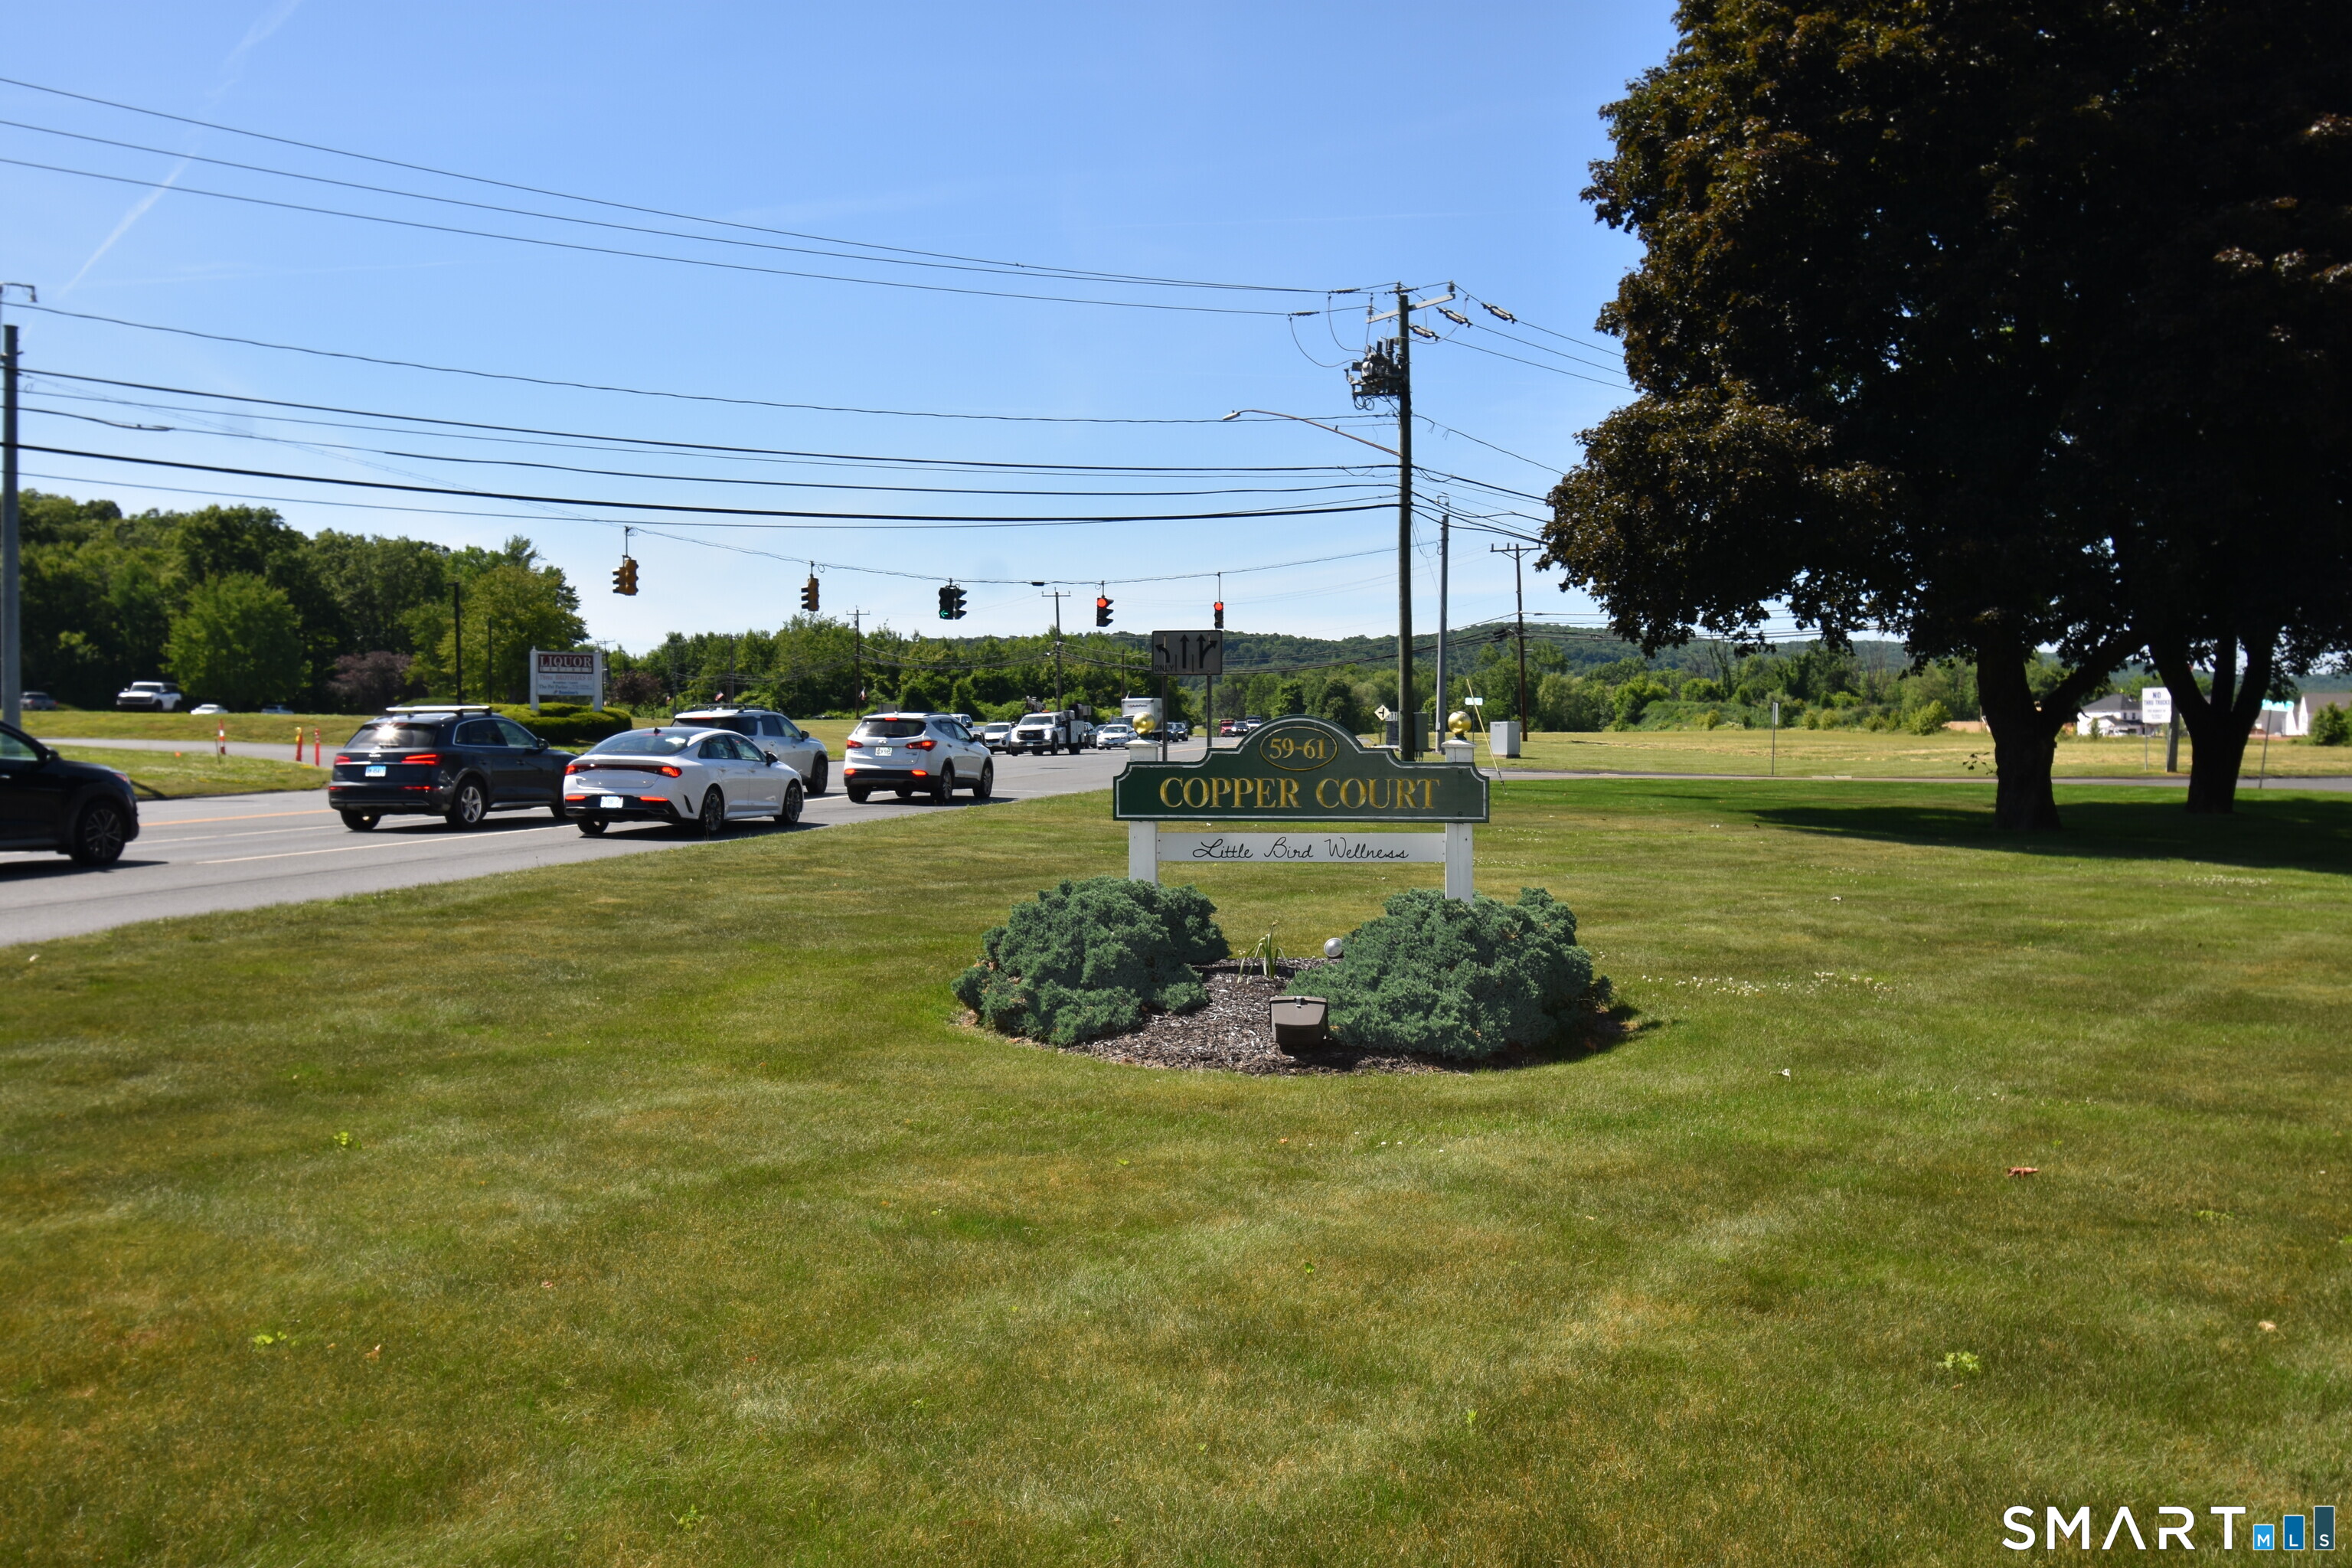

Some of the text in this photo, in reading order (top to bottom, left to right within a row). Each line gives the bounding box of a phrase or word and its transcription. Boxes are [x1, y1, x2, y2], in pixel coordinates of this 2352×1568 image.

[540, 656, 592, 668] LIQUOR
[1155, 664, 1174, 672] ONLY
[1269, 737, 1328, 760] 59-61
[1159, 776, 1441, 810] COPPER COURT
[1192, 836, 1409, 859] Little Bird Wellness
